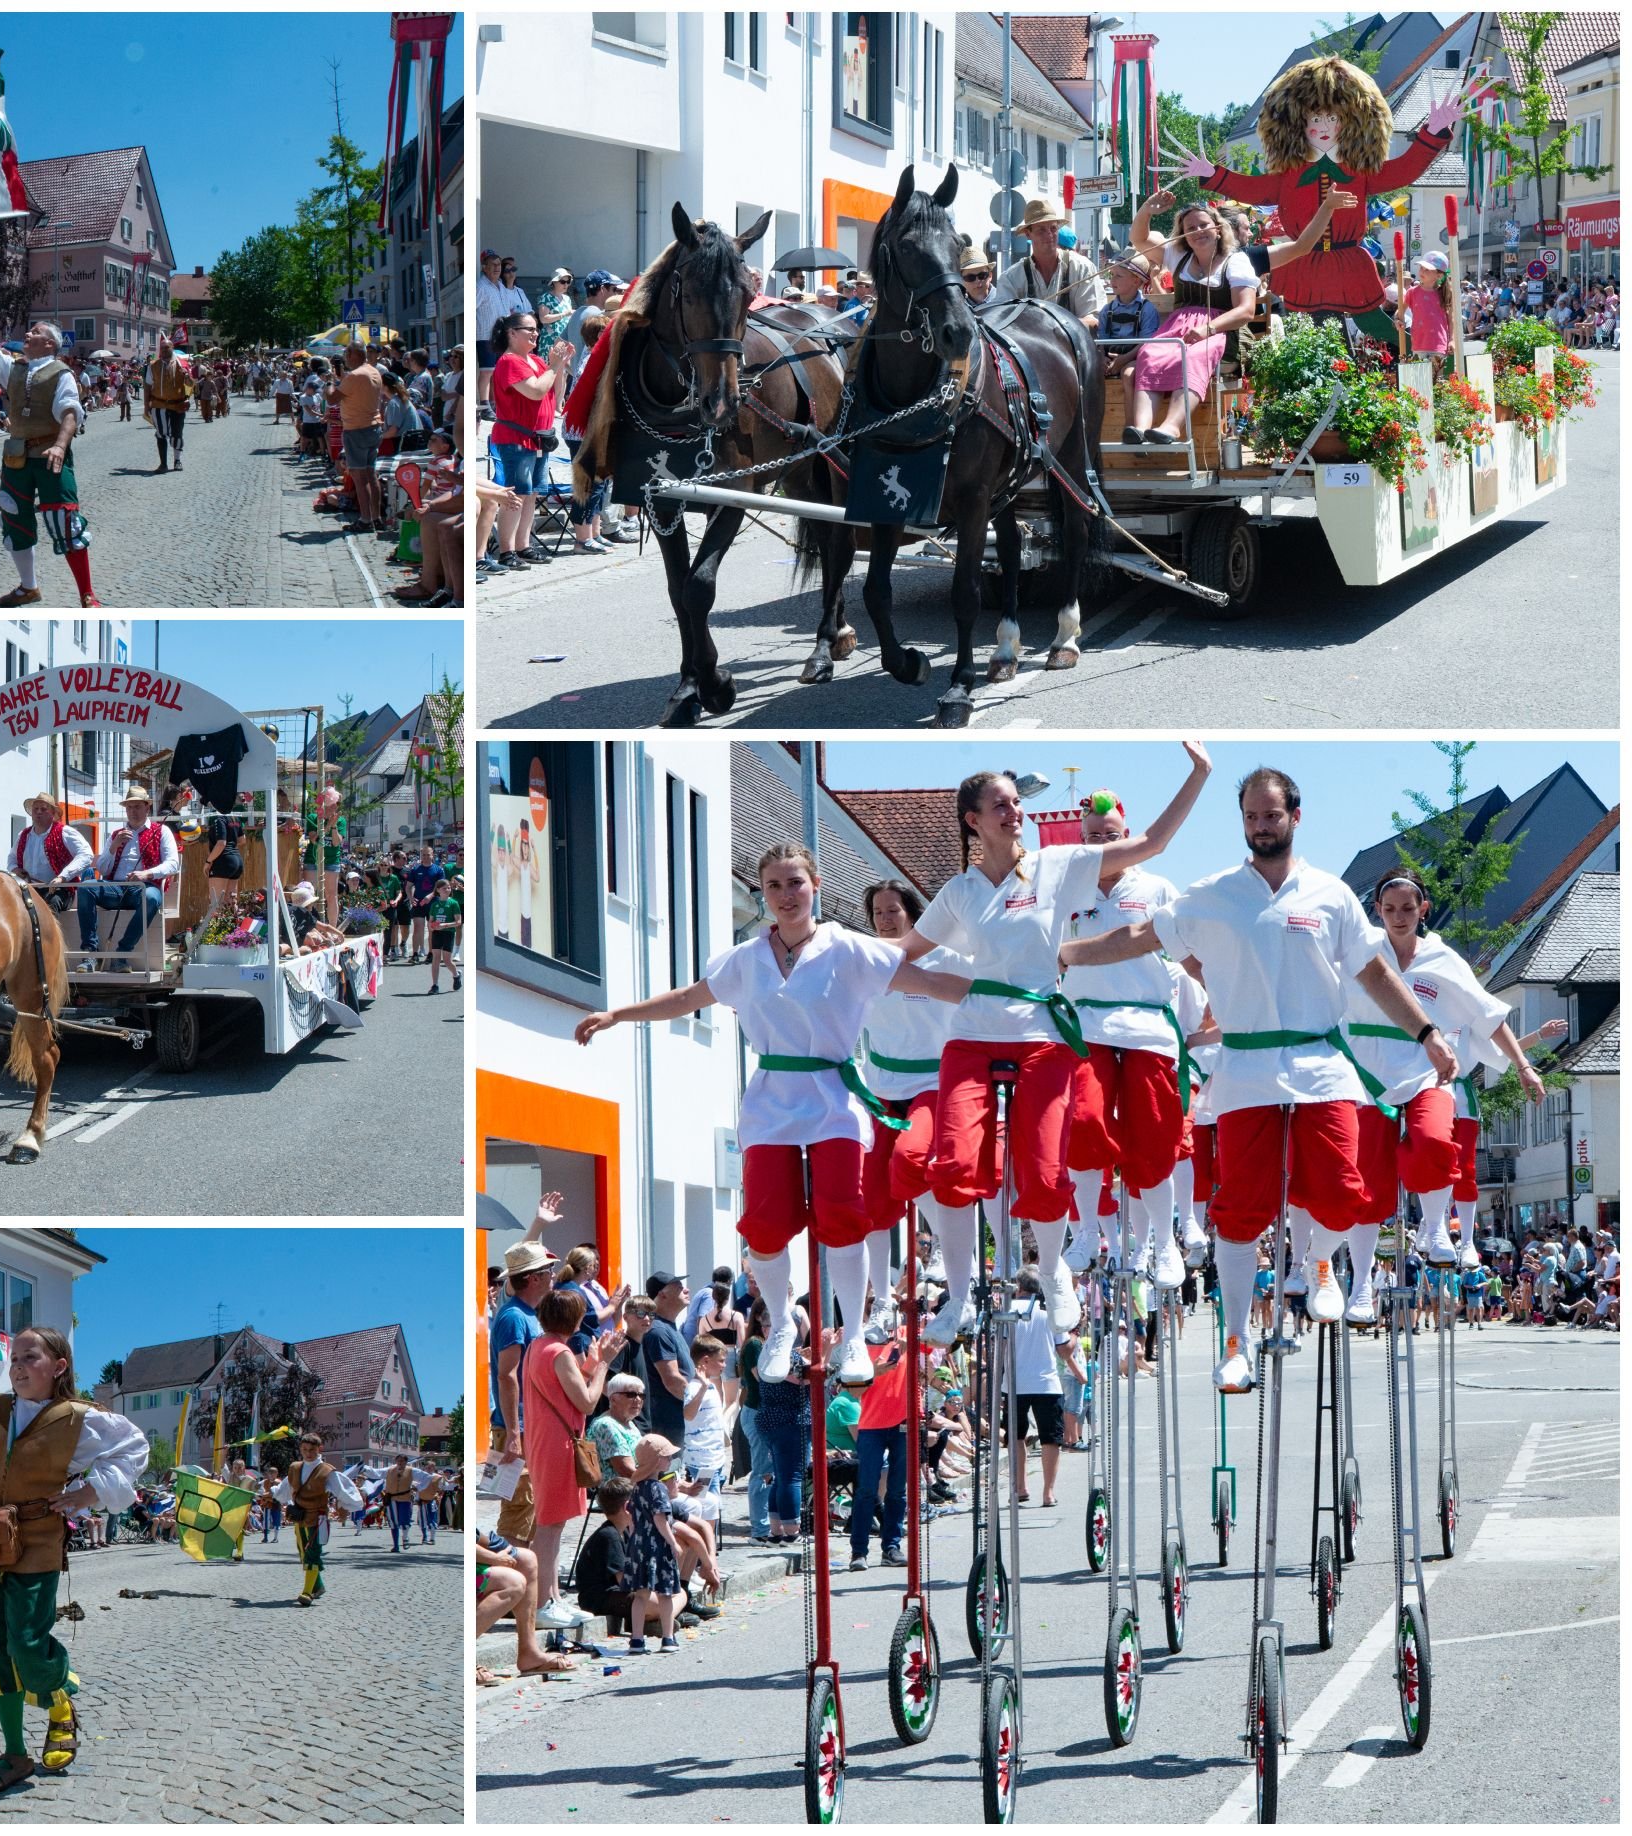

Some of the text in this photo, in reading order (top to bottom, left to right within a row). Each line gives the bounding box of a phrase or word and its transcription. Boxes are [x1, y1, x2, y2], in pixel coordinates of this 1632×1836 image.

[1568, 216, 1620, 239] Räumungs
[1343, 472, 1360, 485] 59
[58, 666, 184, 712] VOLLEYBALL
[3, 706, 40, 738] TSV
[253, 972, 265, 981] 50
